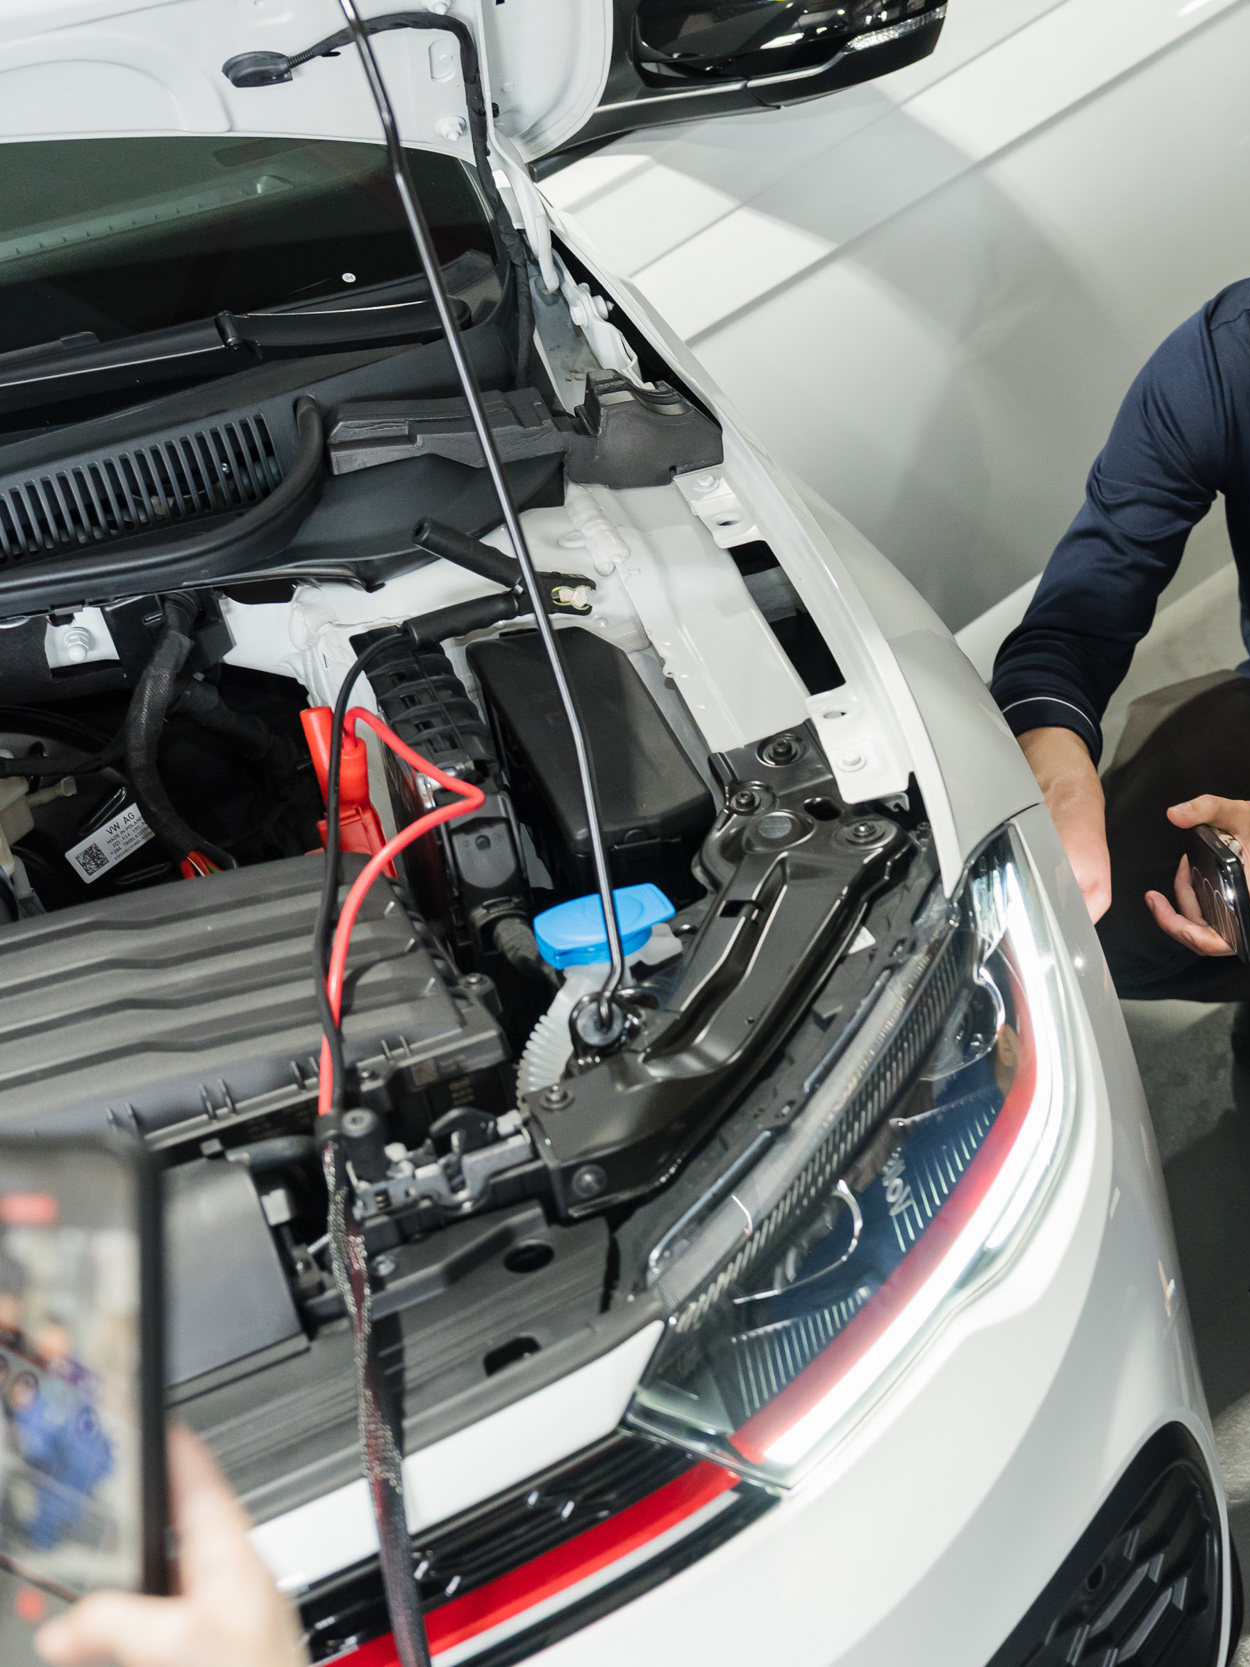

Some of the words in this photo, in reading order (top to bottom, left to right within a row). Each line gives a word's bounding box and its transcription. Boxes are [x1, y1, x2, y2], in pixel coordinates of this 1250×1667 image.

[106, 822, 121, 835] VW
[123, 812, 135, 825] AG
[106, 833, 120, 844] MADE
